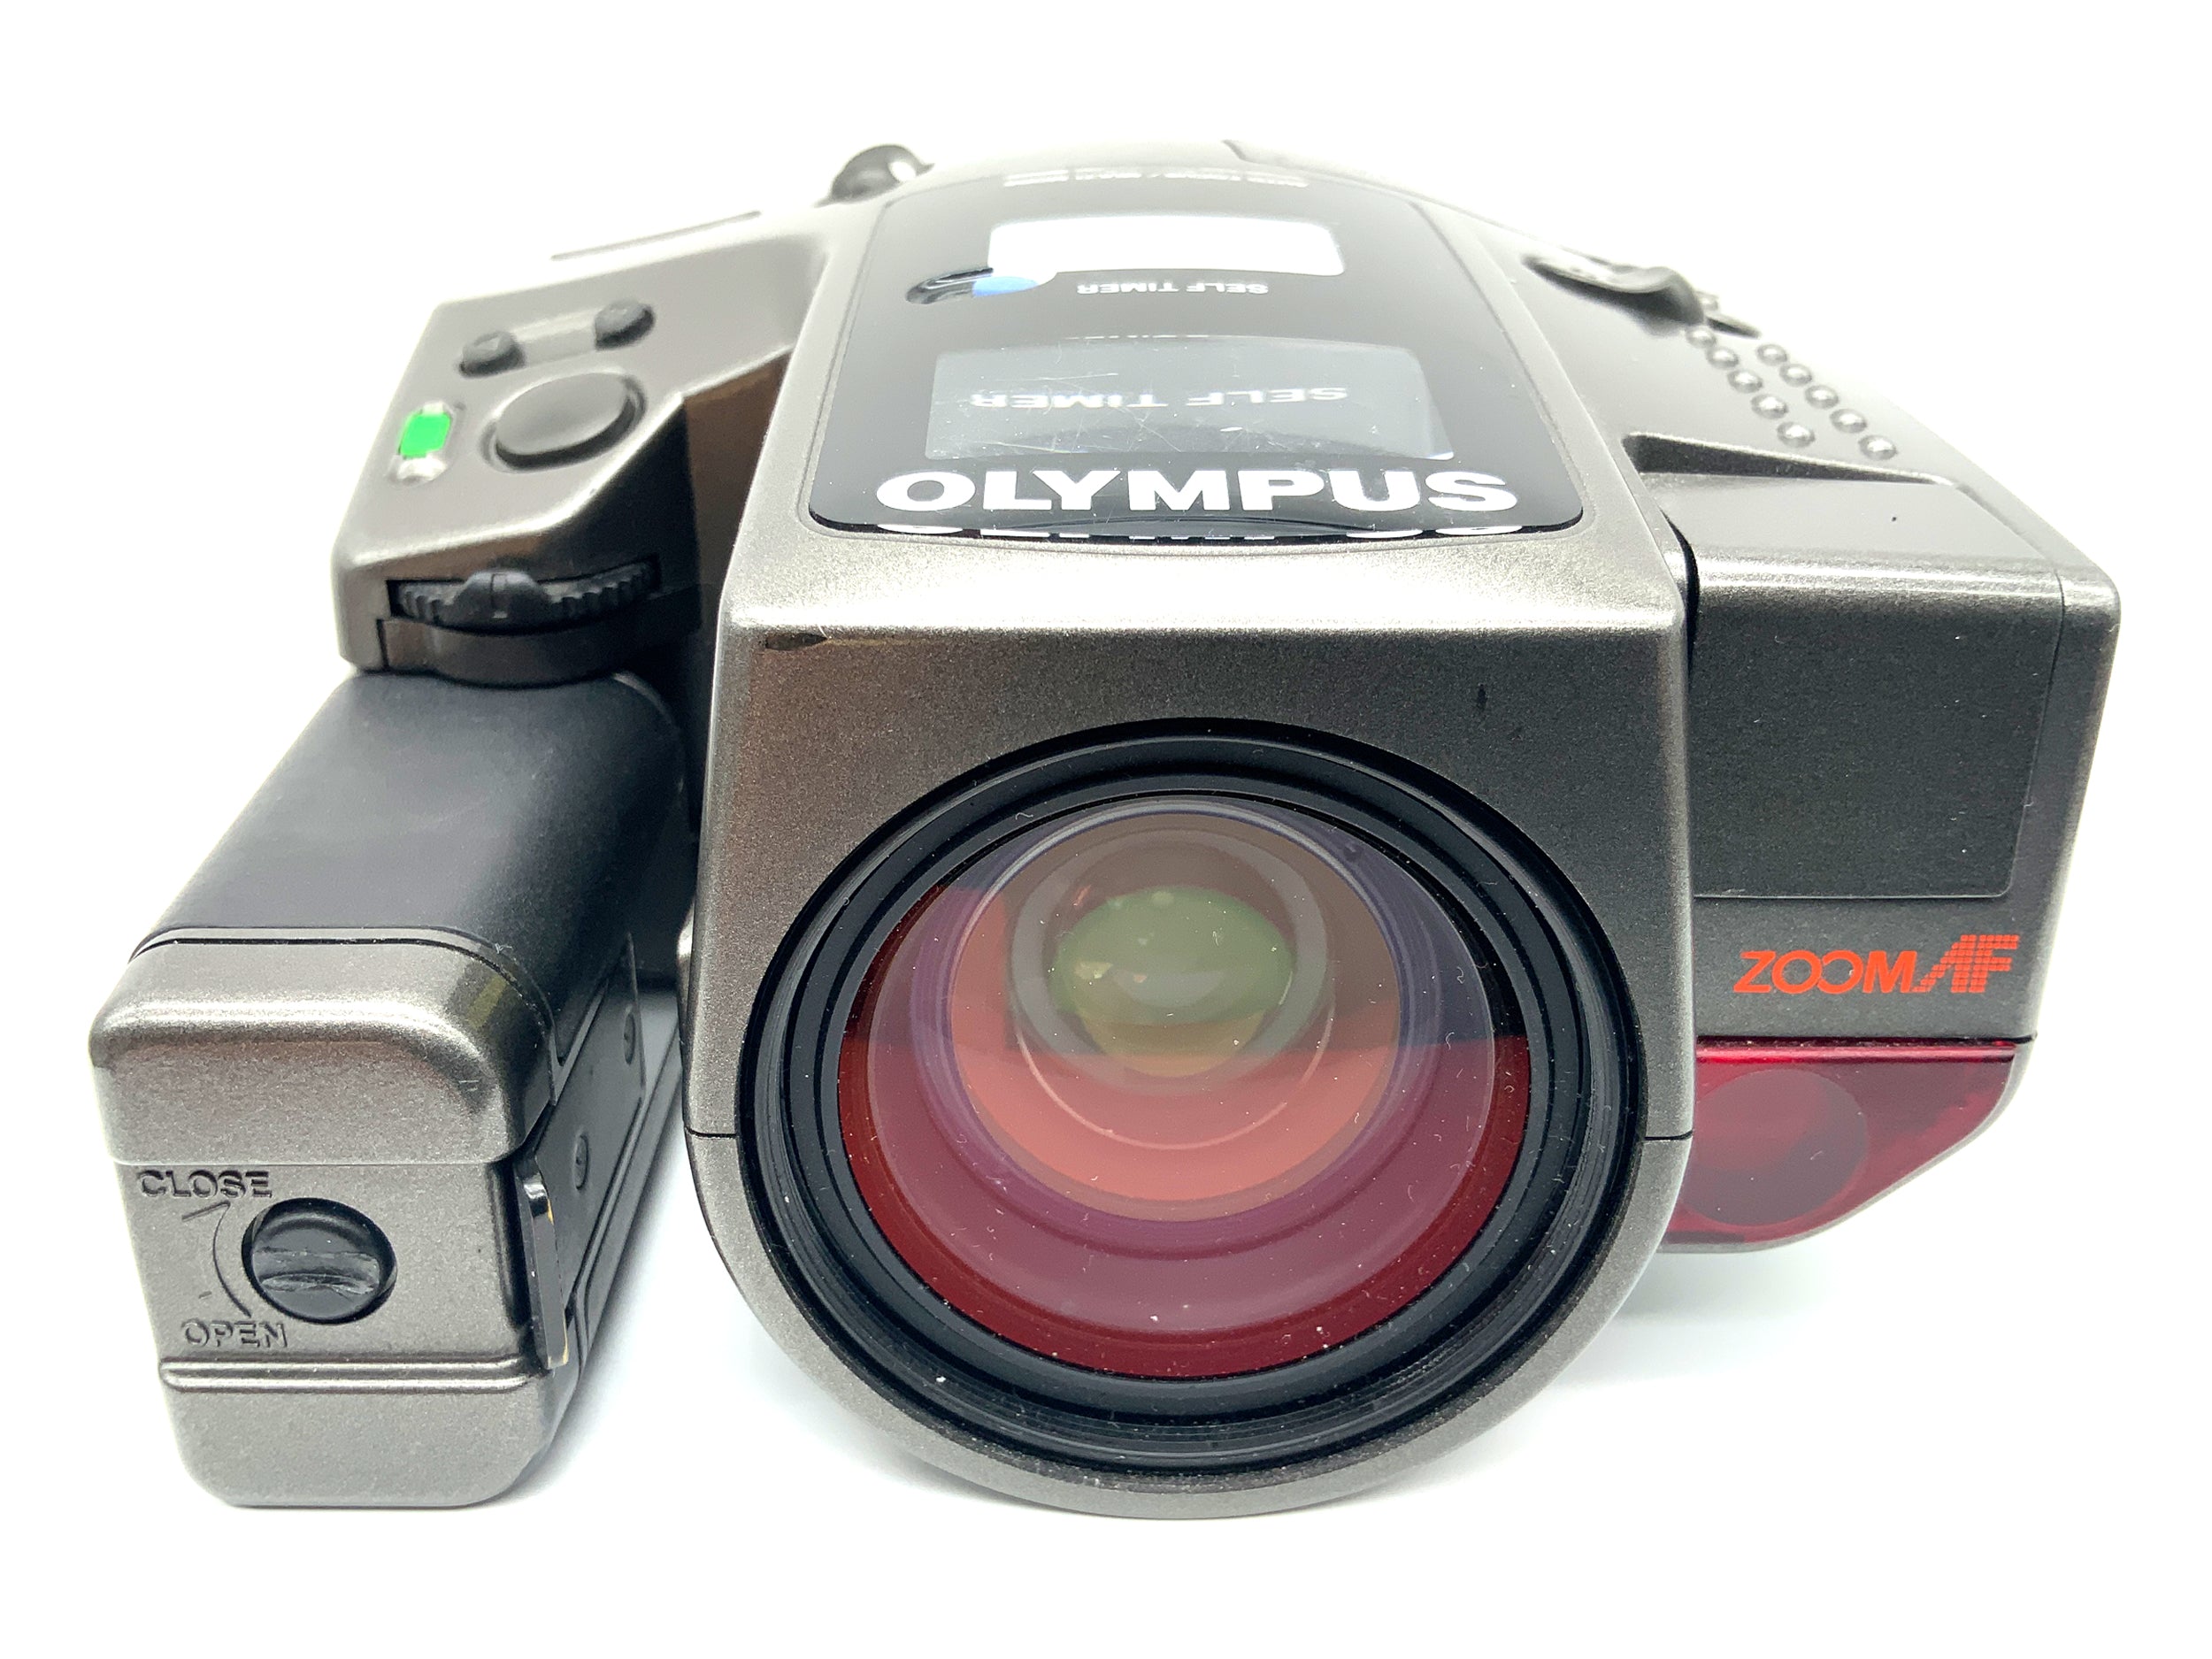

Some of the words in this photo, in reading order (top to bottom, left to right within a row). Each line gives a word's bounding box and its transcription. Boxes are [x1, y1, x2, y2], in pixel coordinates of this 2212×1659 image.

[1076, 281, 1179, 295] TIMER
[1187, 281, 1269, 295] SELF
[971, 392, 1169, 409] TIMER
[1186, 387, 1348, 407] SELF
[876, 469, 1519, 512] OLYMPUS
[136, 1169, 273, 1199] CLOSE
[181, 1318, 288, 1348] OPEN
